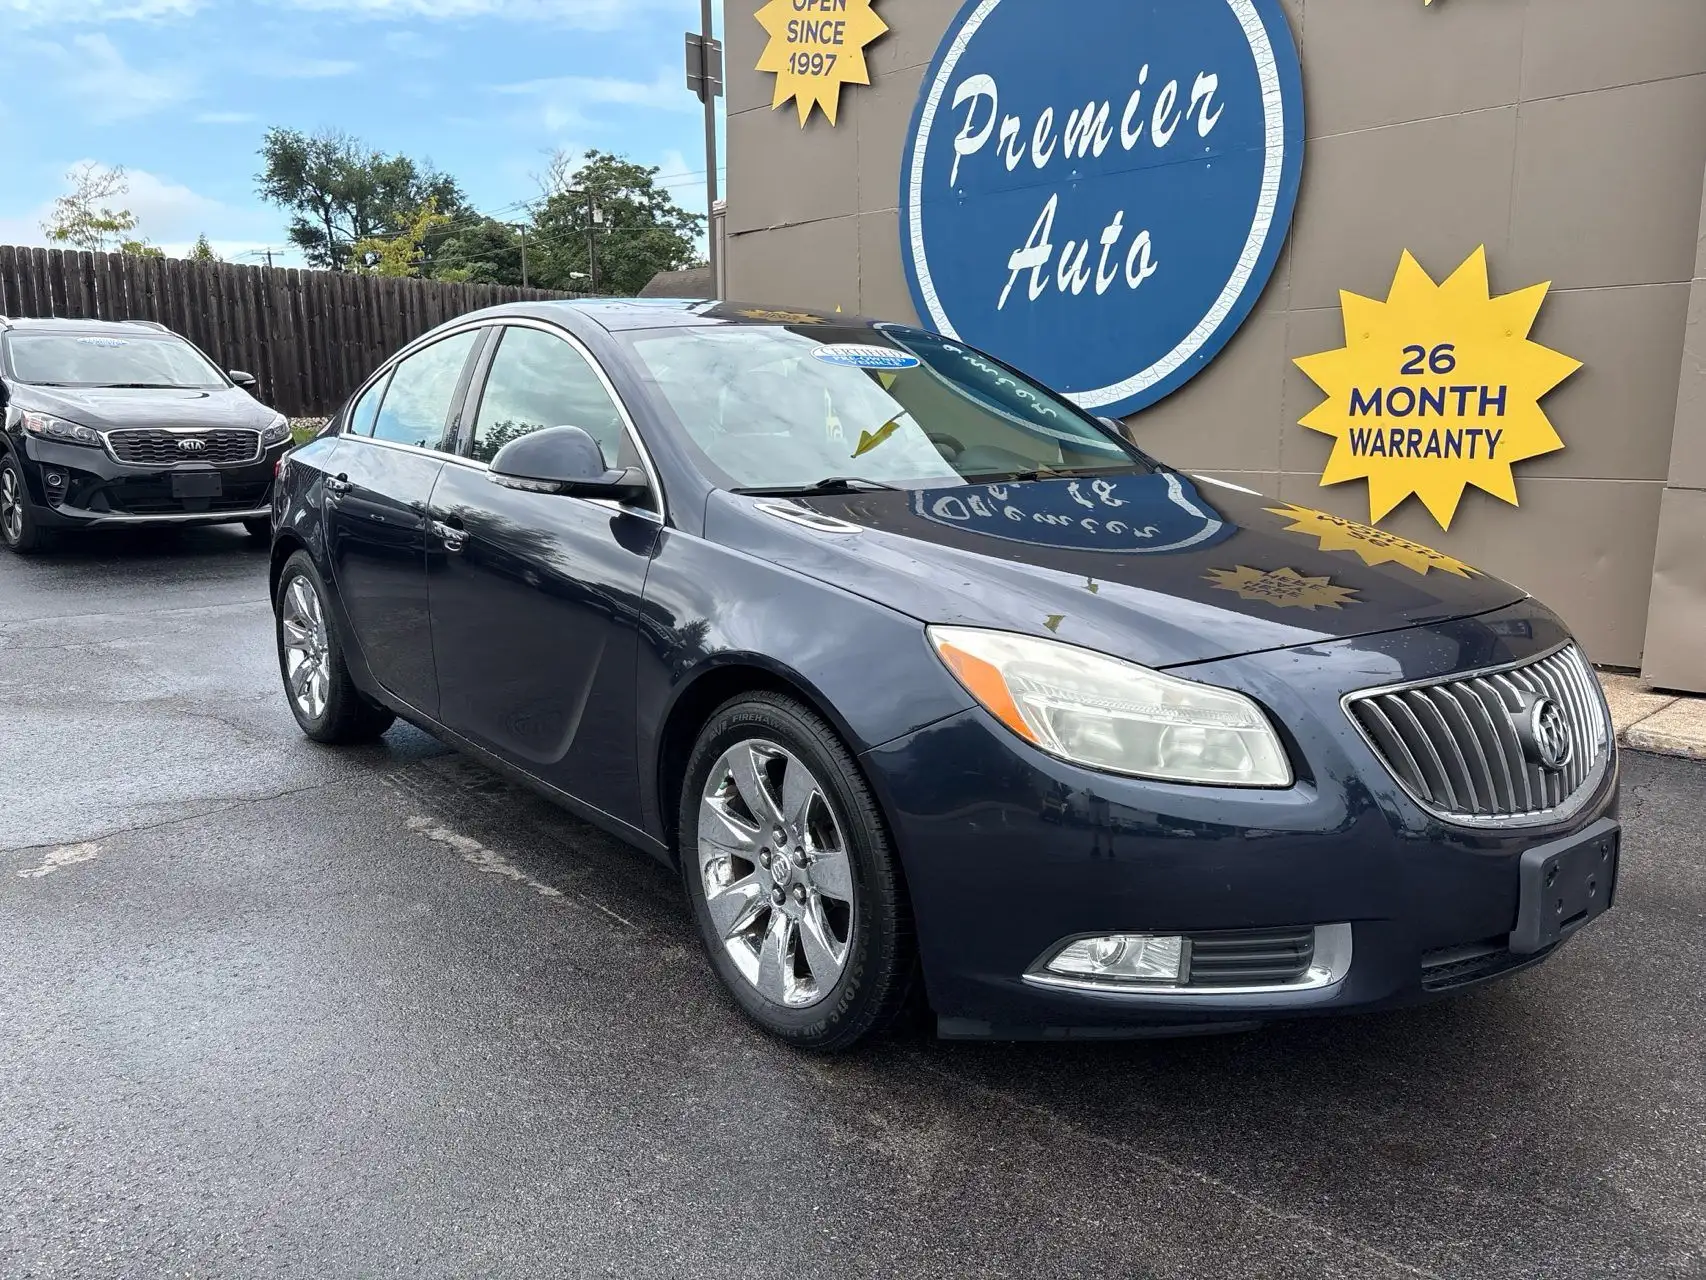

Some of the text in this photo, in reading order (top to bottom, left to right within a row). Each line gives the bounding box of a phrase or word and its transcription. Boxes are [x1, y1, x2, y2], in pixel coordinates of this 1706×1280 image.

[787, 20, 846, 45] SINCE
[789, 52, 837, 76] 1997
[950, 63, 1225, 188] Premier
[997, 193, 1158, 310] Auto
[1400, 343, 1456, 375] 26
[1348, 385, 1507, 417] MONTH
[1349, 427, 1503, 459] WARRANTY
